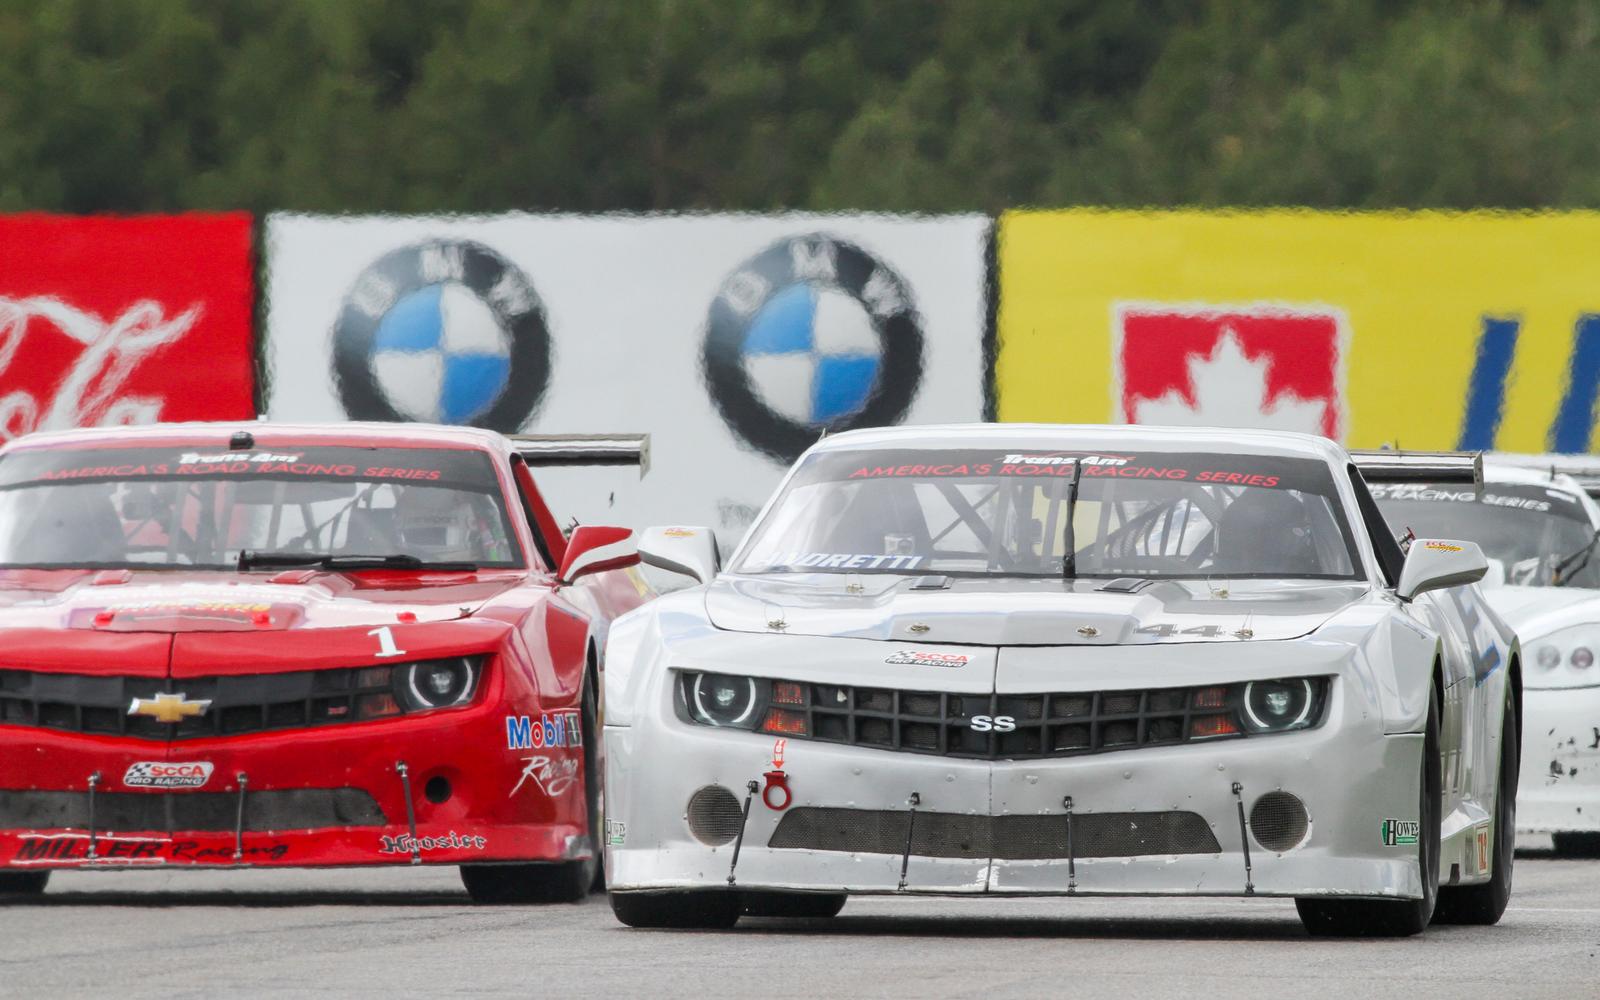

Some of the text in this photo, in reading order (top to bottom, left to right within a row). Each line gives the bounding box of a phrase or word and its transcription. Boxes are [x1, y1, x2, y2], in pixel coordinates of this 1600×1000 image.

[36, 463, 441, 481] AMERICA'S ROAD RACING SERIES
[848, 464, 1281, 487] AMERICA'S ROAD RACING SERIES
[367, 626, 407, 658] 1
[913, 659, 963, 668] RACING
[914, 652, 969, 663] SCCA
[506, 714, 566, 750] Mobil
[970, 715, 1016, 732] SS
[151, 765, 205, 777] SCCA
[126, 777, 204, 785] PRO RACING
[17, 838, 163, 860] MILLER
[379, 830, 488, 854] Hoosier
